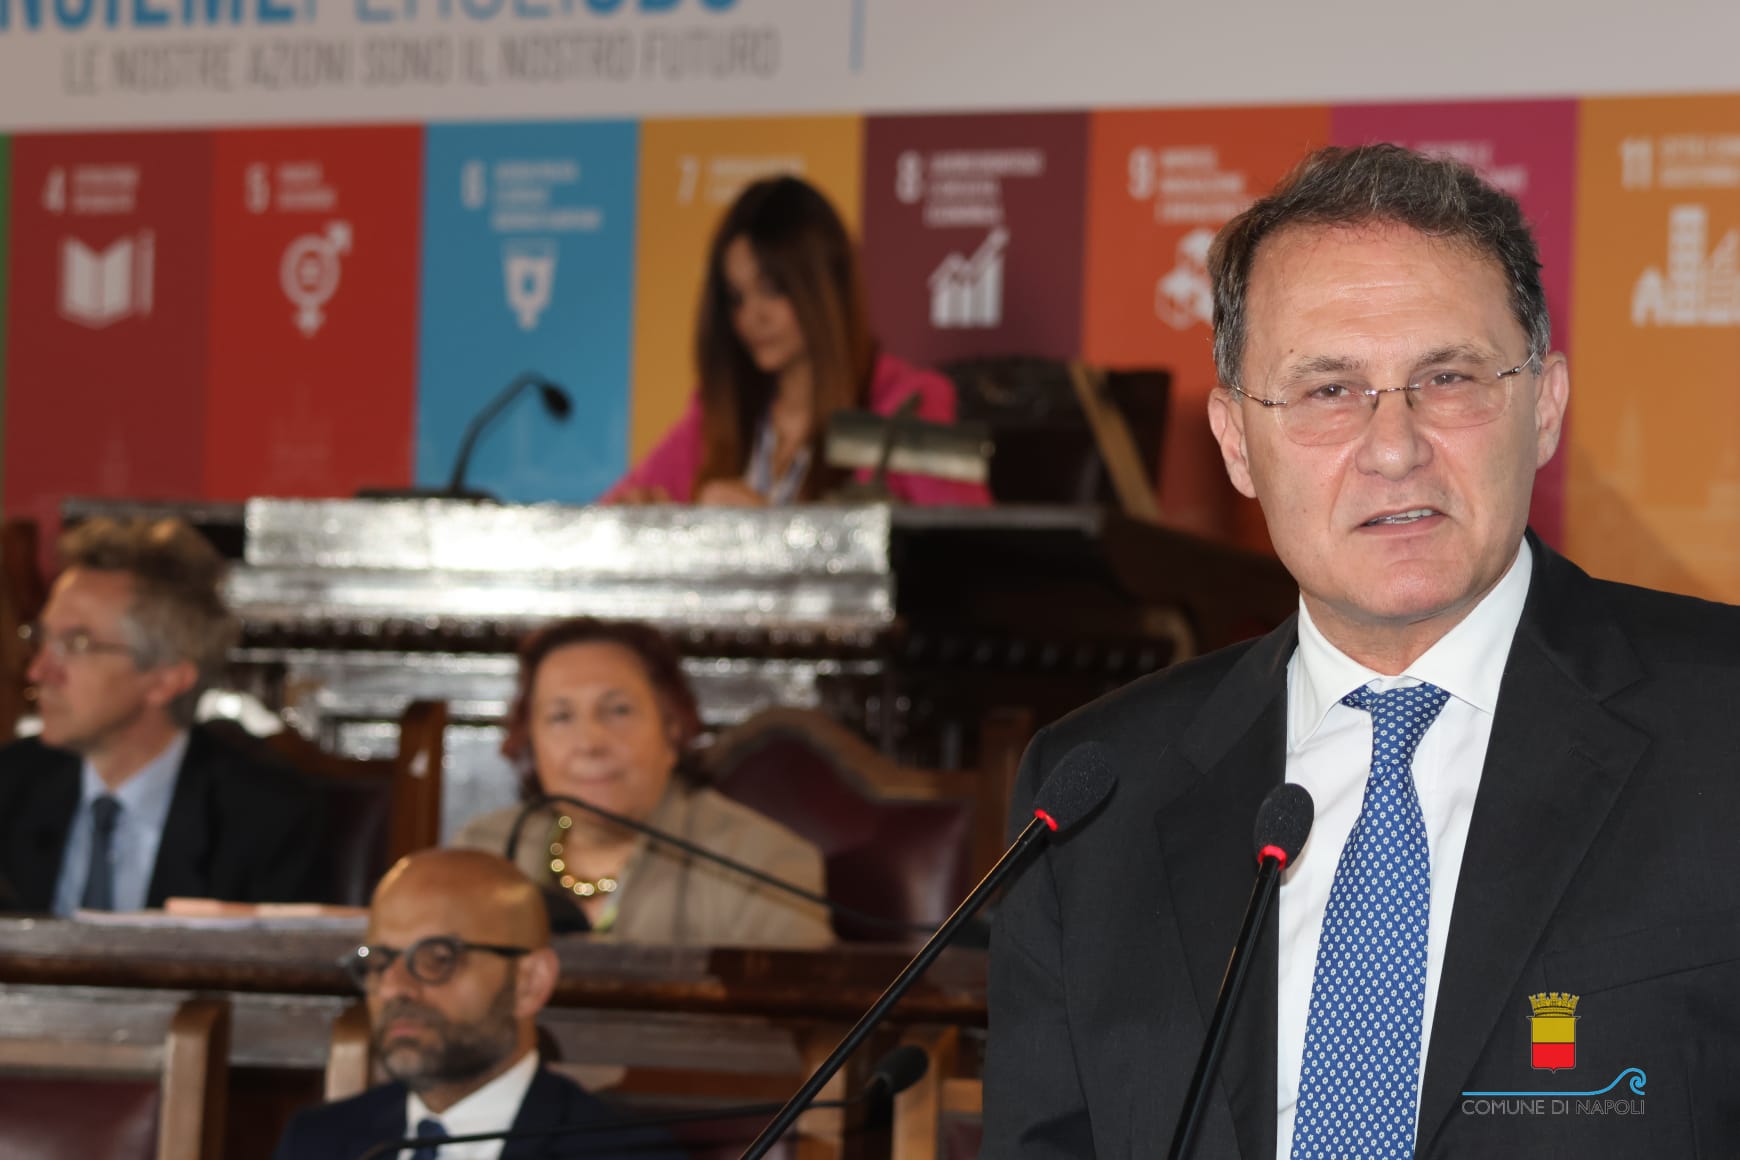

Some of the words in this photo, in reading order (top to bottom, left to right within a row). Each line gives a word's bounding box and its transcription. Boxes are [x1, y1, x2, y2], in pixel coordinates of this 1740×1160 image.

[63, 48, 102, 95] LE
[113, 40, 235, 94] NOSTRE
[247, 37, 352, 89] AZIONI
[362, 34, 452, 87] SONO
[460, 35, 488, 86] IL
[504, 30, 632, 84] NOSTRO
[642, 27, 780, 80] FUTURO
[246, 163, 270, 213] 5
[678, 155, 700, 203] 7
[897, 152, 922, 202] 8
[1128, 148, 1155, 199] 9
[1620, 138, 1651, 189] 11
[43, 167, 66, 212] 4
